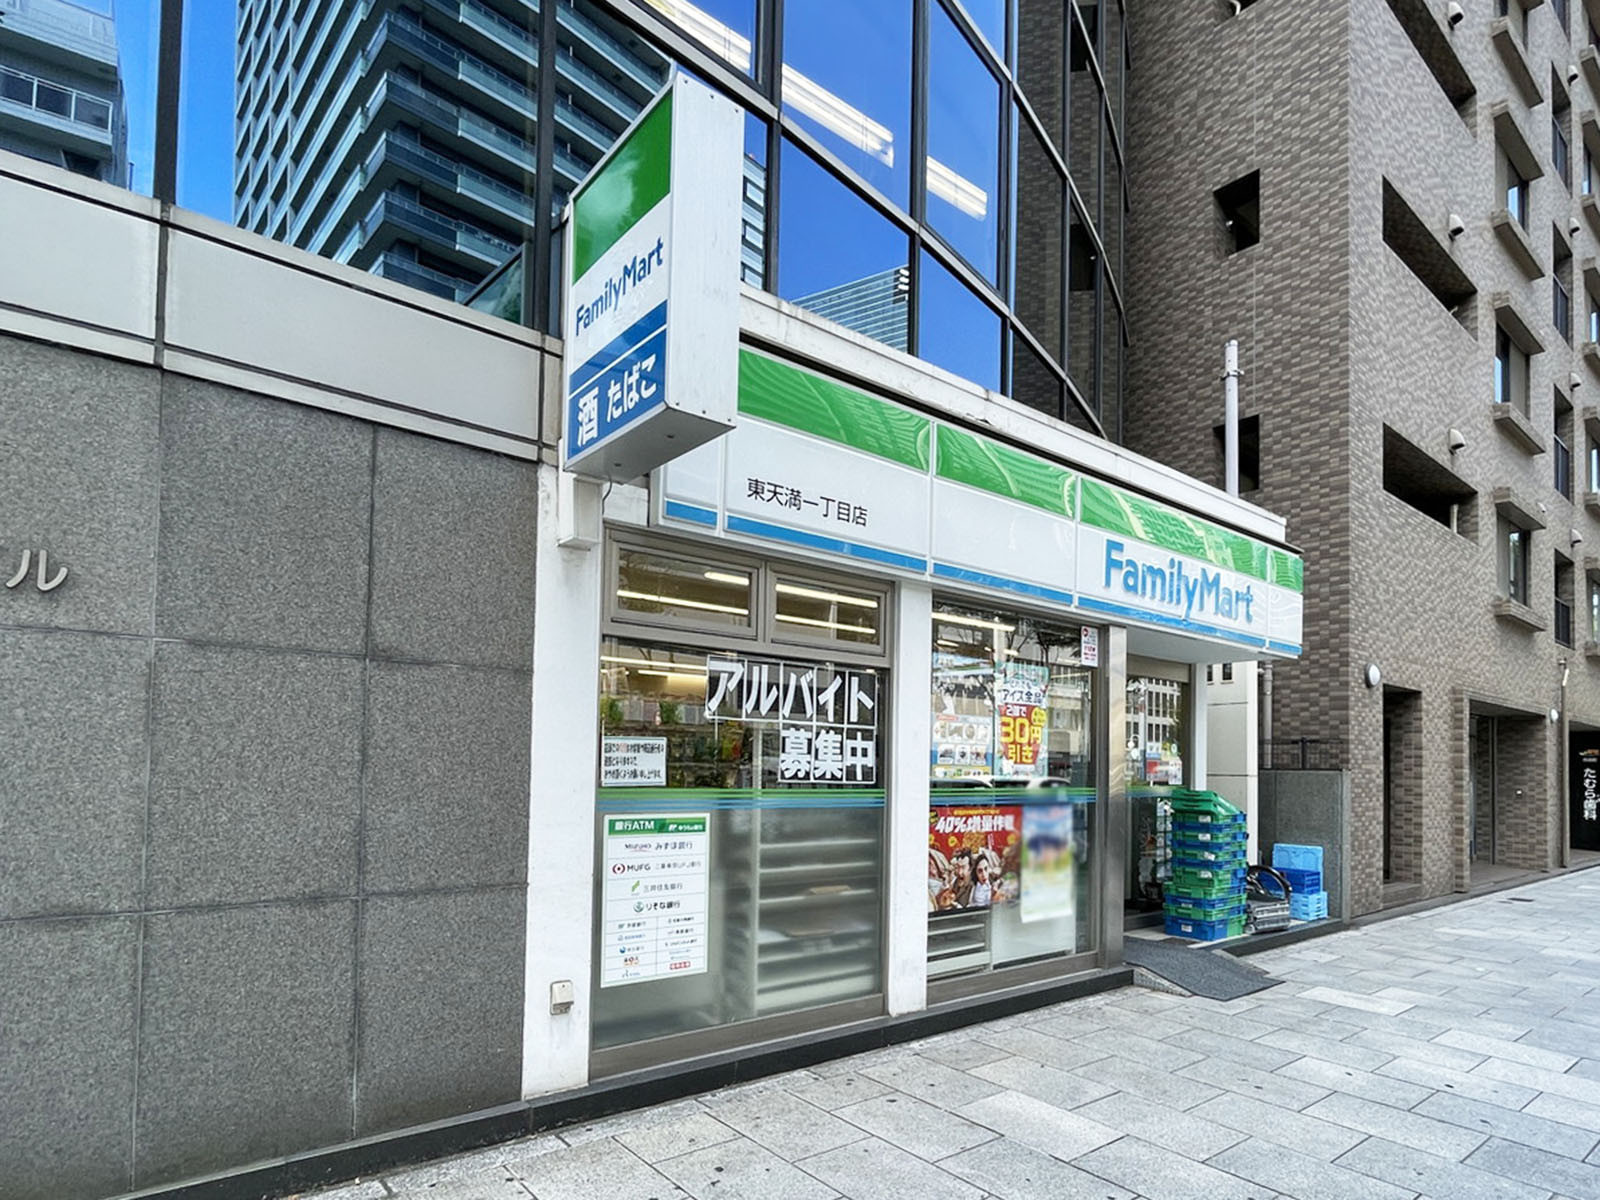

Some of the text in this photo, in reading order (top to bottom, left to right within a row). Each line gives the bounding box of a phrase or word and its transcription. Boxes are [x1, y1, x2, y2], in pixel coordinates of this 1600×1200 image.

[575, 237, 664, 337] FamilyMart
[576, 353, 658, 447] 酒 たばこ
[746, 477, 868, 527] 東天満一丁目店
[5, 549, 69, 592] ル
[1104, 539, 1254, 624] FamilyMart
[706, 660, 875, 723] アルバイト
[1000, 716, 1042, 745] 30円
[780, 727, 876, 781] 募集中
[1007, 744, 1034, 764] 引き
[614, 820, 655, 831] 銀行ATM
[627, 863, 651, 872] MUFG
[645, 901, 681, 911] りそな銀行
